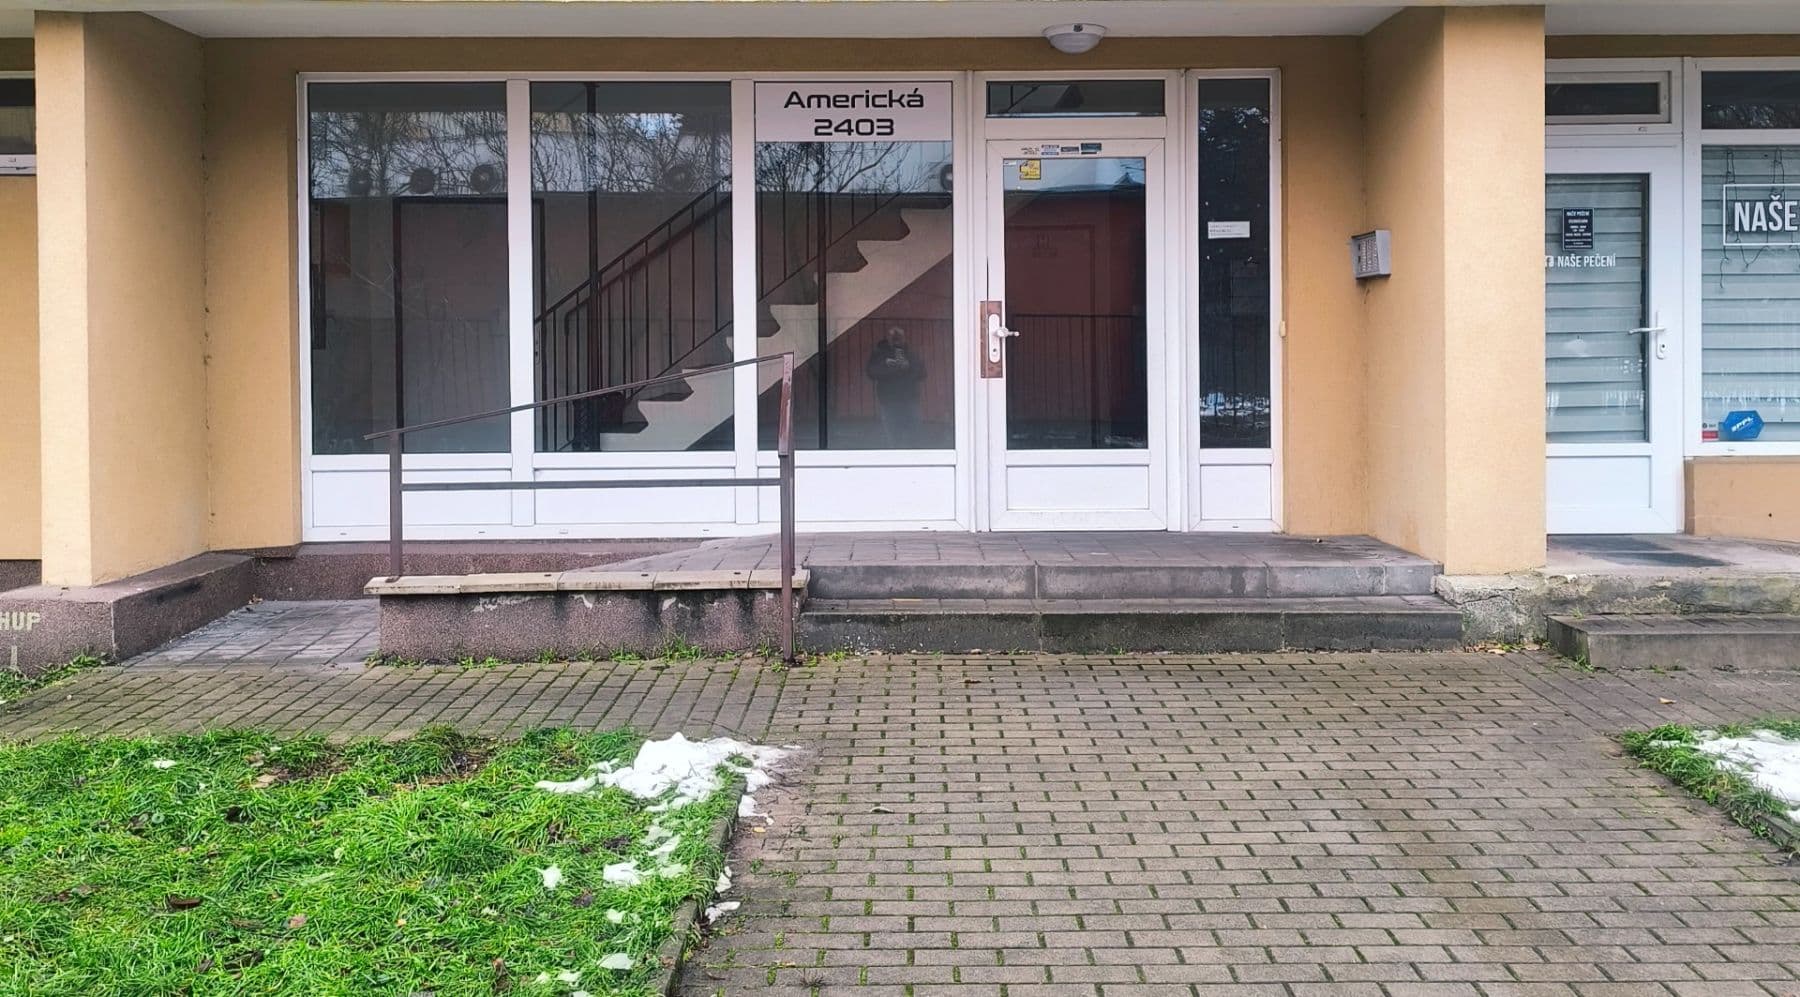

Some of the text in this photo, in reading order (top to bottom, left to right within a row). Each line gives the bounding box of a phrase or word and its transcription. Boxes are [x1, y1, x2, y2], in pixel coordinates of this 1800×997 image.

[784, 88, 924, 109] Americká
[814, 118, 894, 136] 2403
[1734, 194, 1799, 232] NAŠE
[1557, 253, 1616, 268] NAŠE PEČENÍ
[0, 611, 41, 631] HUP
